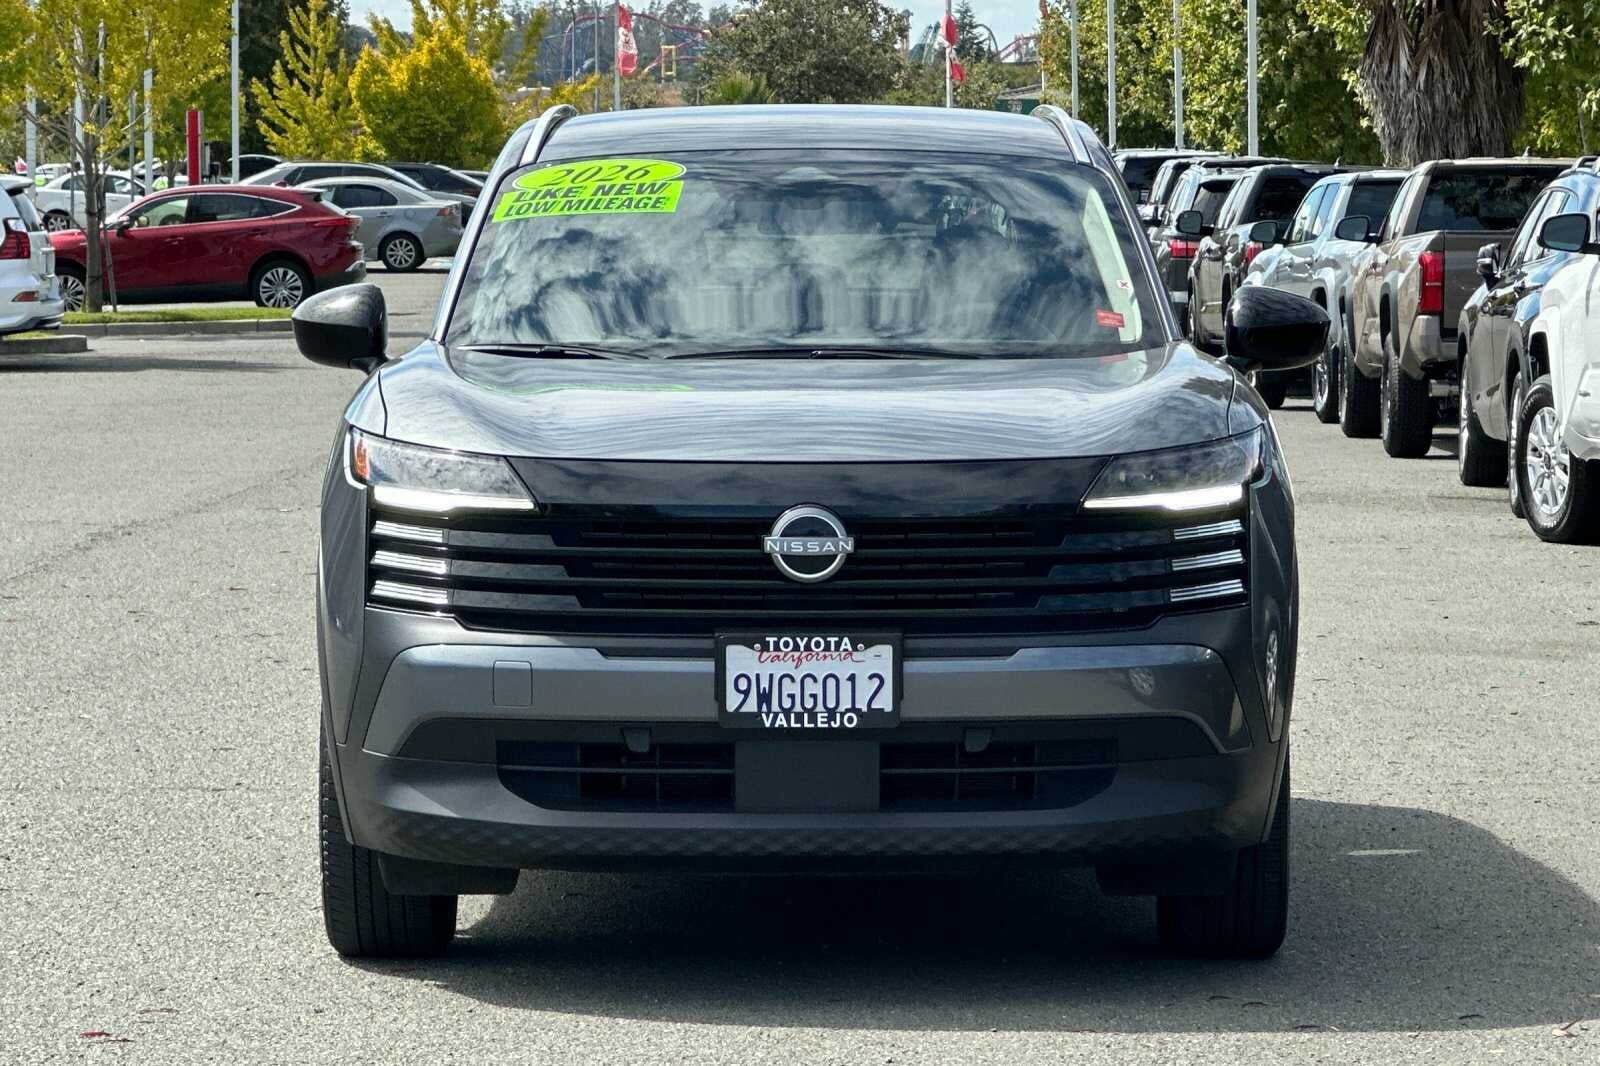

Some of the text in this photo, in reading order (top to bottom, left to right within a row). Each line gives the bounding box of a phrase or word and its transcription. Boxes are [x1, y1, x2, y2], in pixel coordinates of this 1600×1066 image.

[541, 164, 658, 187] 2026
[514, 182, 670, 203] LIKE NEW
[503, 196, 667, 217] LOW MILEAGE
[766, 540, 852, 552] NISSAN
[765, 636, 853, 652] TOYOTA
[757, 651, 865, 669] California
[733, 672, 885, 712] 9WGG012
[761, 712, 858, 728] VALLEJO
